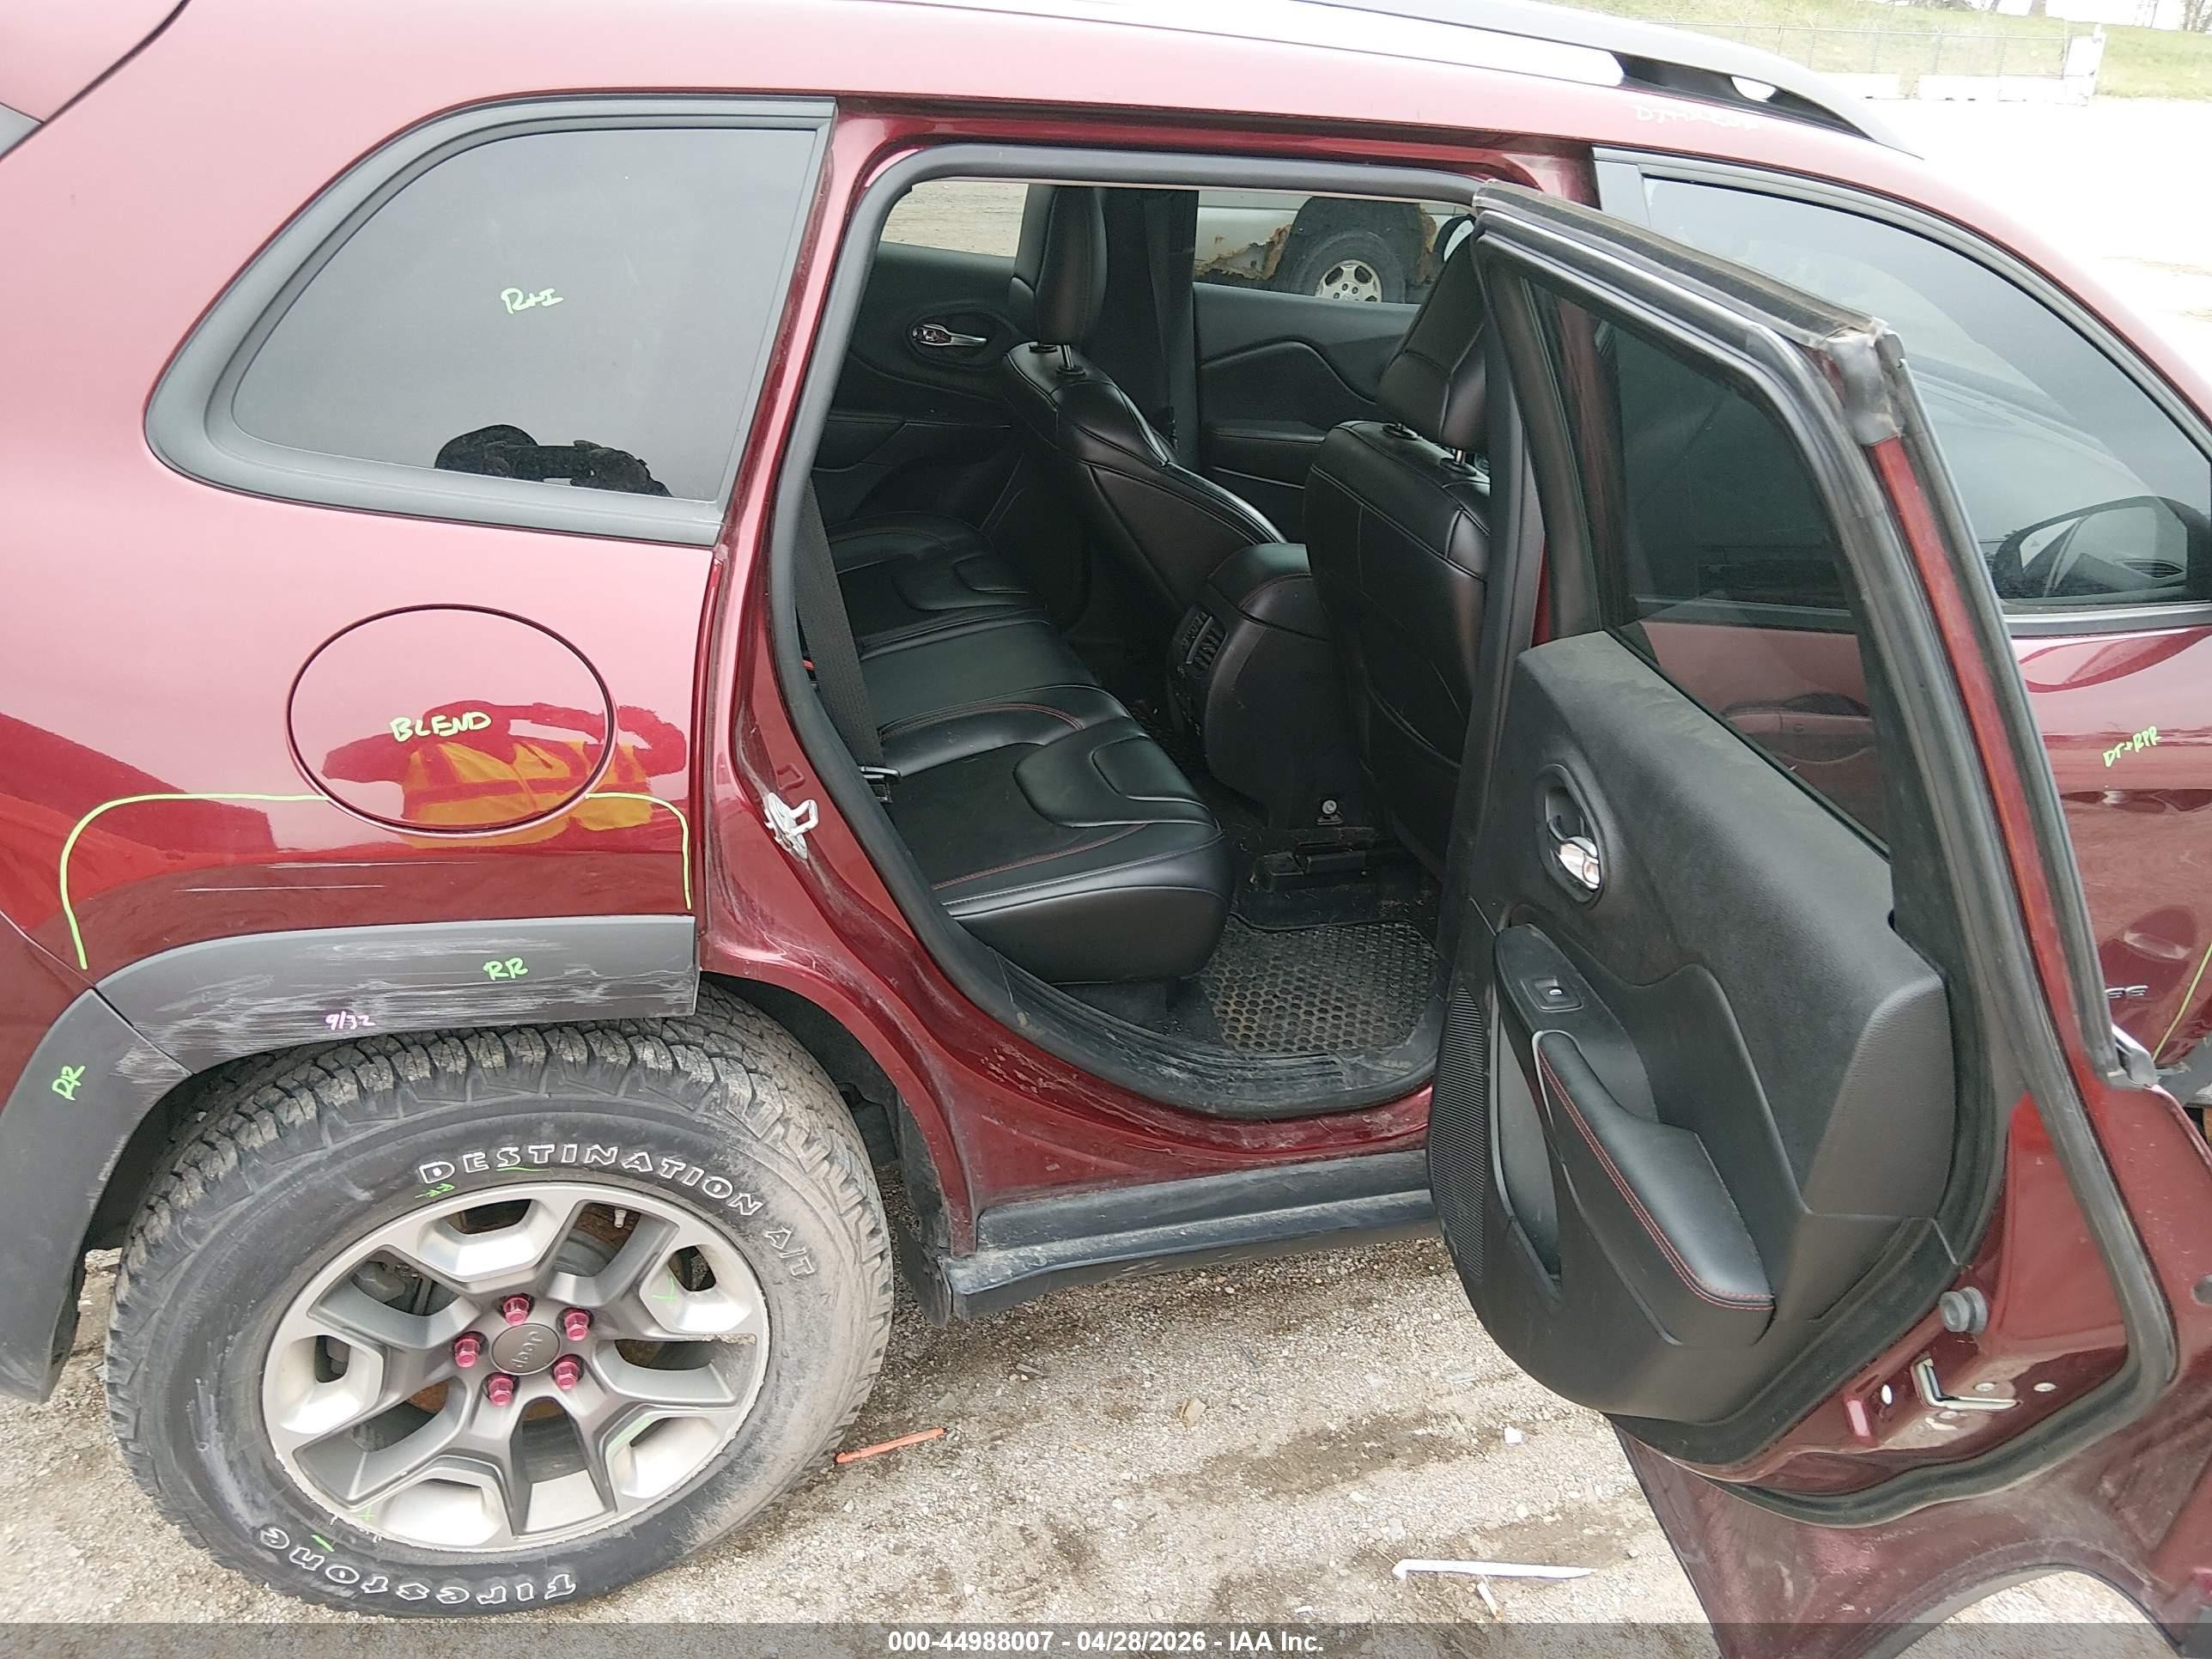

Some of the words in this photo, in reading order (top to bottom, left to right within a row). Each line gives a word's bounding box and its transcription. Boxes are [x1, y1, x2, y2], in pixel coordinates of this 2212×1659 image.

[389, 711, 491, 742] BLEND
[483, 957, 528, 981] RR
[325, 1011, 377, 1030] 9/32
[419, 1145, 763, 1216] DESTINATION
[763, 1226, 816, 1277] A/T
